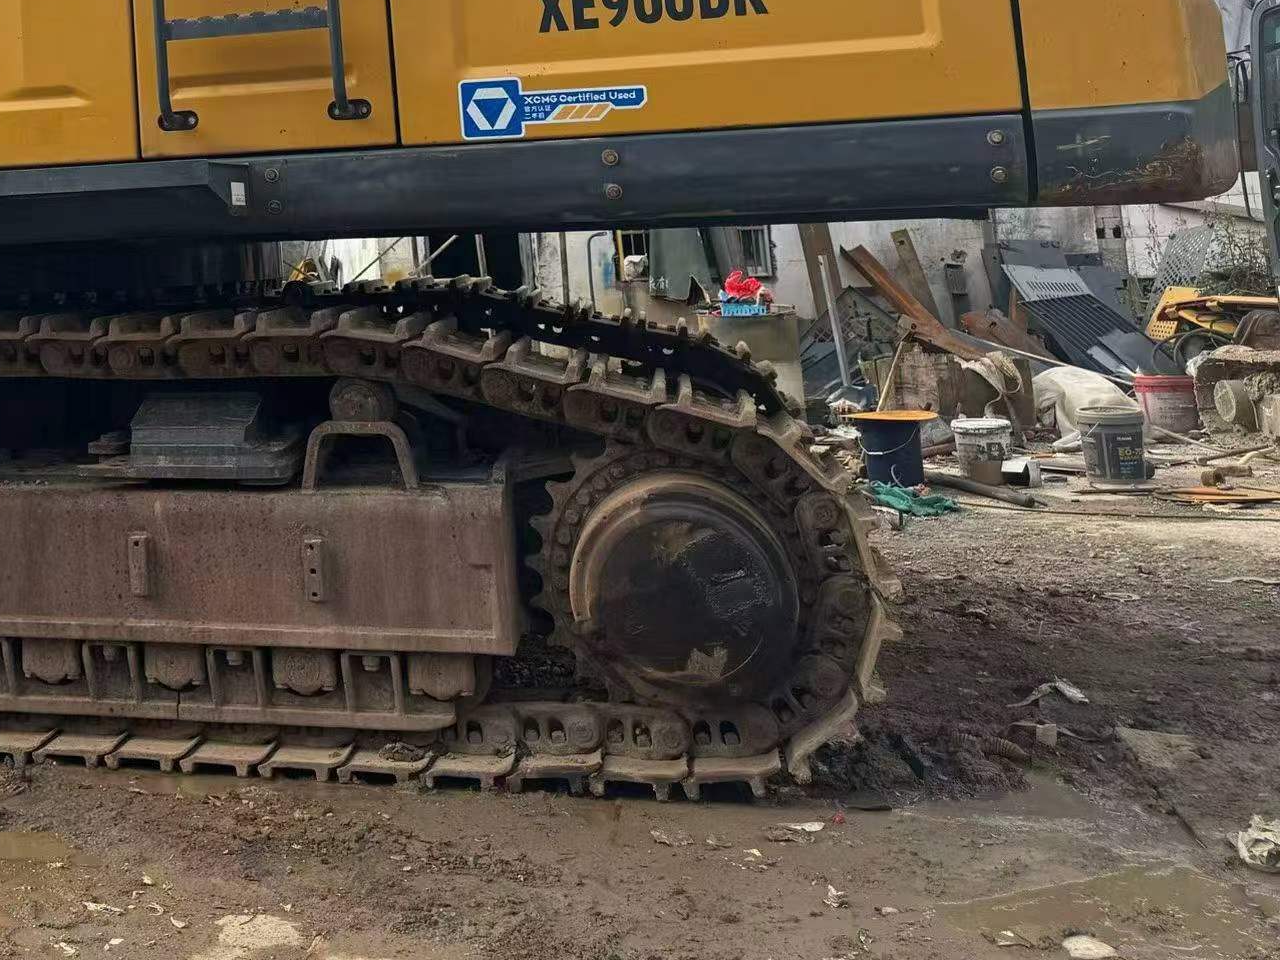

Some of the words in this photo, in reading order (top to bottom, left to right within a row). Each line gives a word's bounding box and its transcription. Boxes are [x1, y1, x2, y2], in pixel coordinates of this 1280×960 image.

[523, 95, 558, 105] XCMG
[559, 91, 607, 103] Certified
[609, 89, 636, 100] Used
